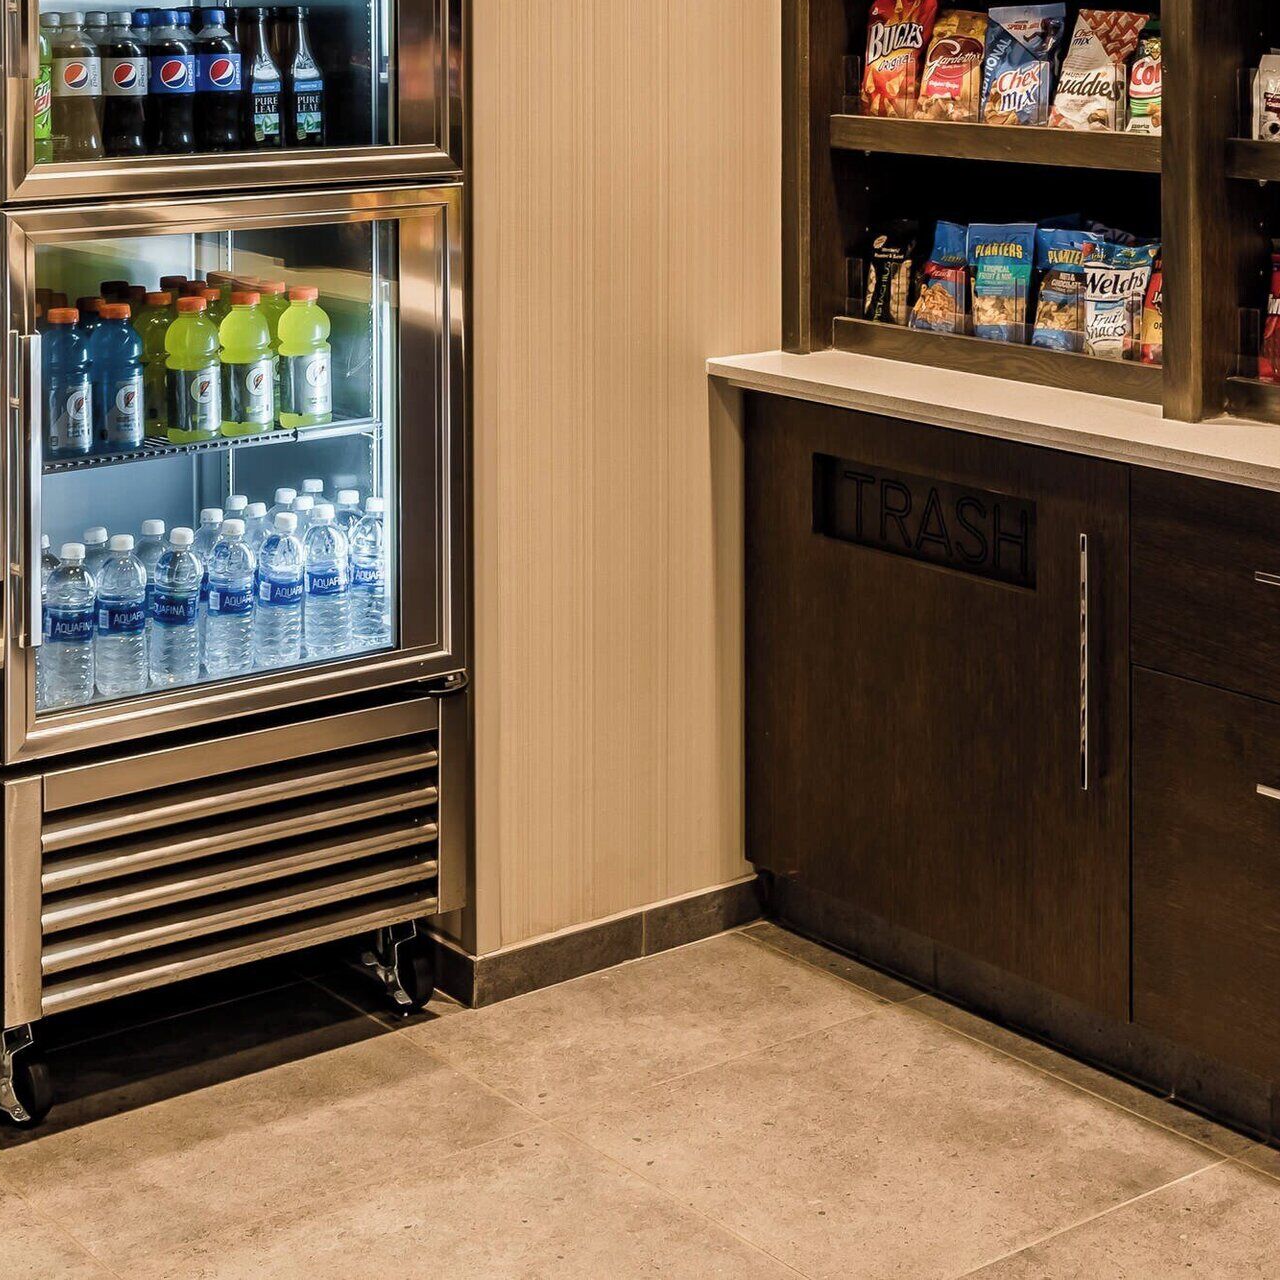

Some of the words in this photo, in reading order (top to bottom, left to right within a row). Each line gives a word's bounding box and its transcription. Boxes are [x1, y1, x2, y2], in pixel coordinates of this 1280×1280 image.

[867, 22, 923, 65] BUGLES
[998, 65, 1040, 94] Chex
[255, 96, 278, 105] PURE
[297, 95, 320, 105] PURE
[255, 105, 277, 113] LEAF
[975, 243, 1023, 259] PLANTERS
[844, 470, 1028, 578] TRASH
[55, 622, 91, 634] AQUAFIN
